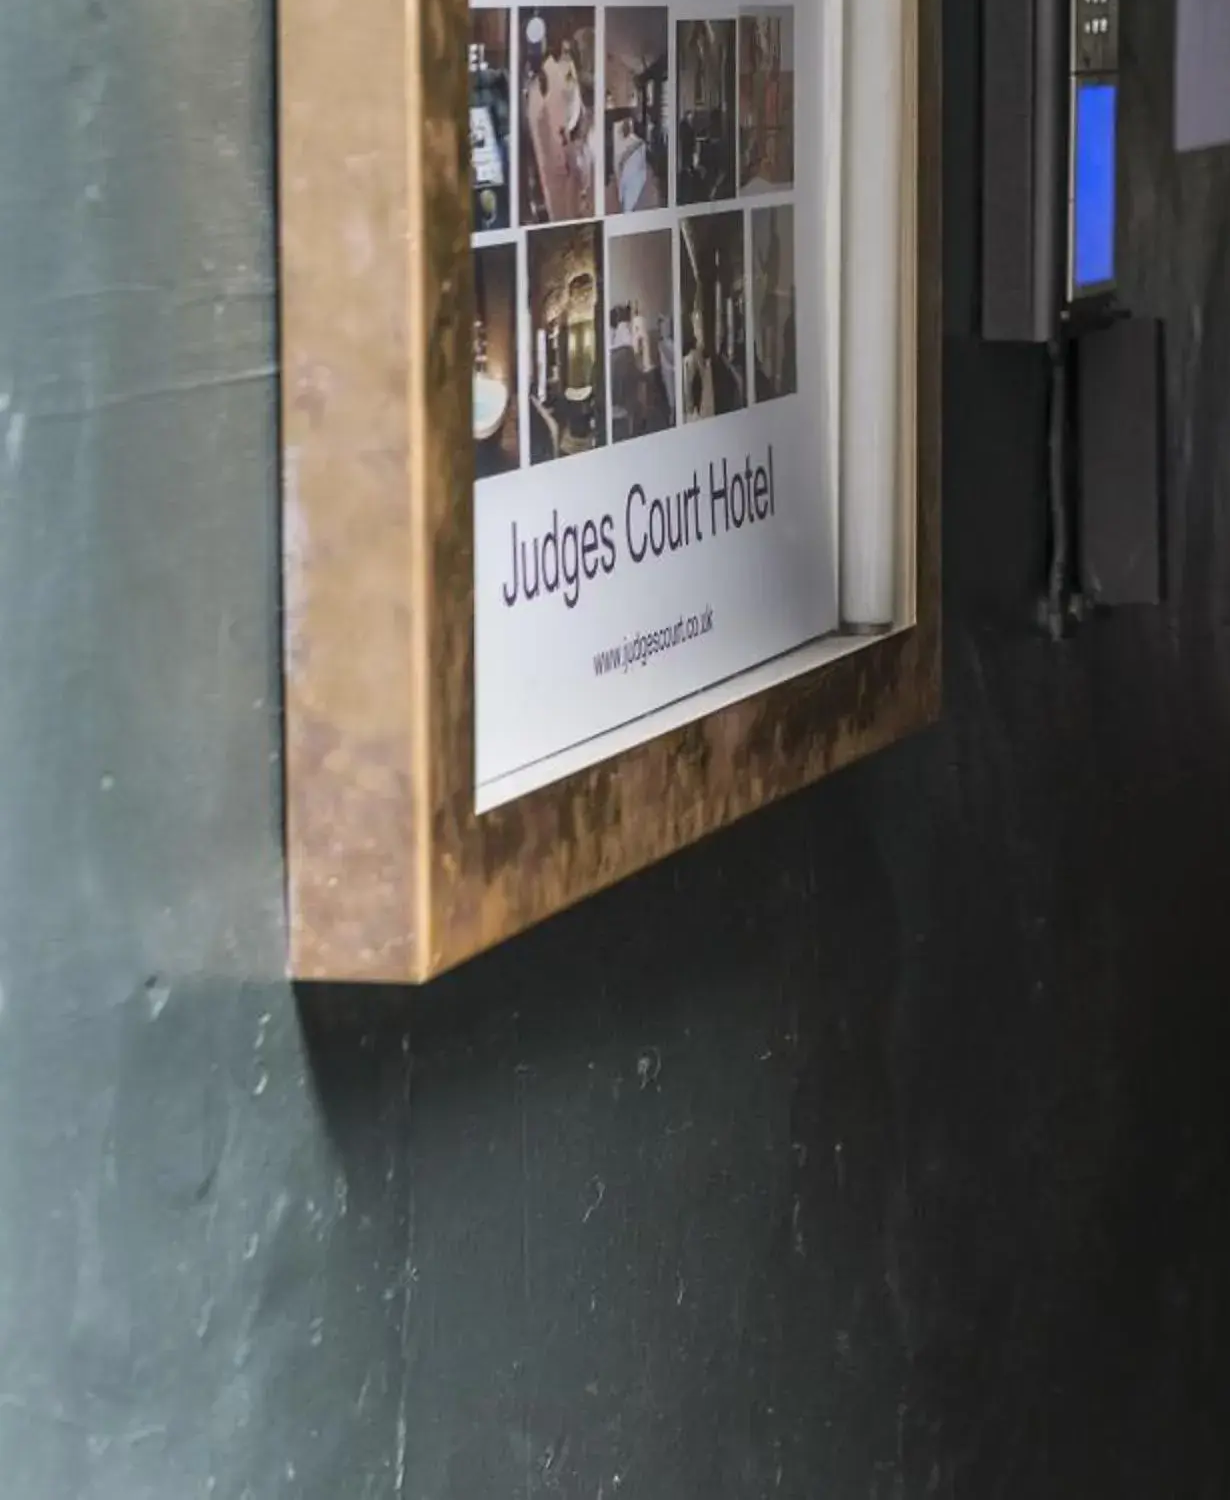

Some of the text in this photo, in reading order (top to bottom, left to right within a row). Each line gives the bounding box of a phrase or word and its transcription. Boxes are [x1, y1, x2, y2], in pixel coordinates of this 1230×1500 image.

[502, 444, 776, 608] Judges Court Hotel
[593, 602, 713, 676] www.judgescourt.co.uk
